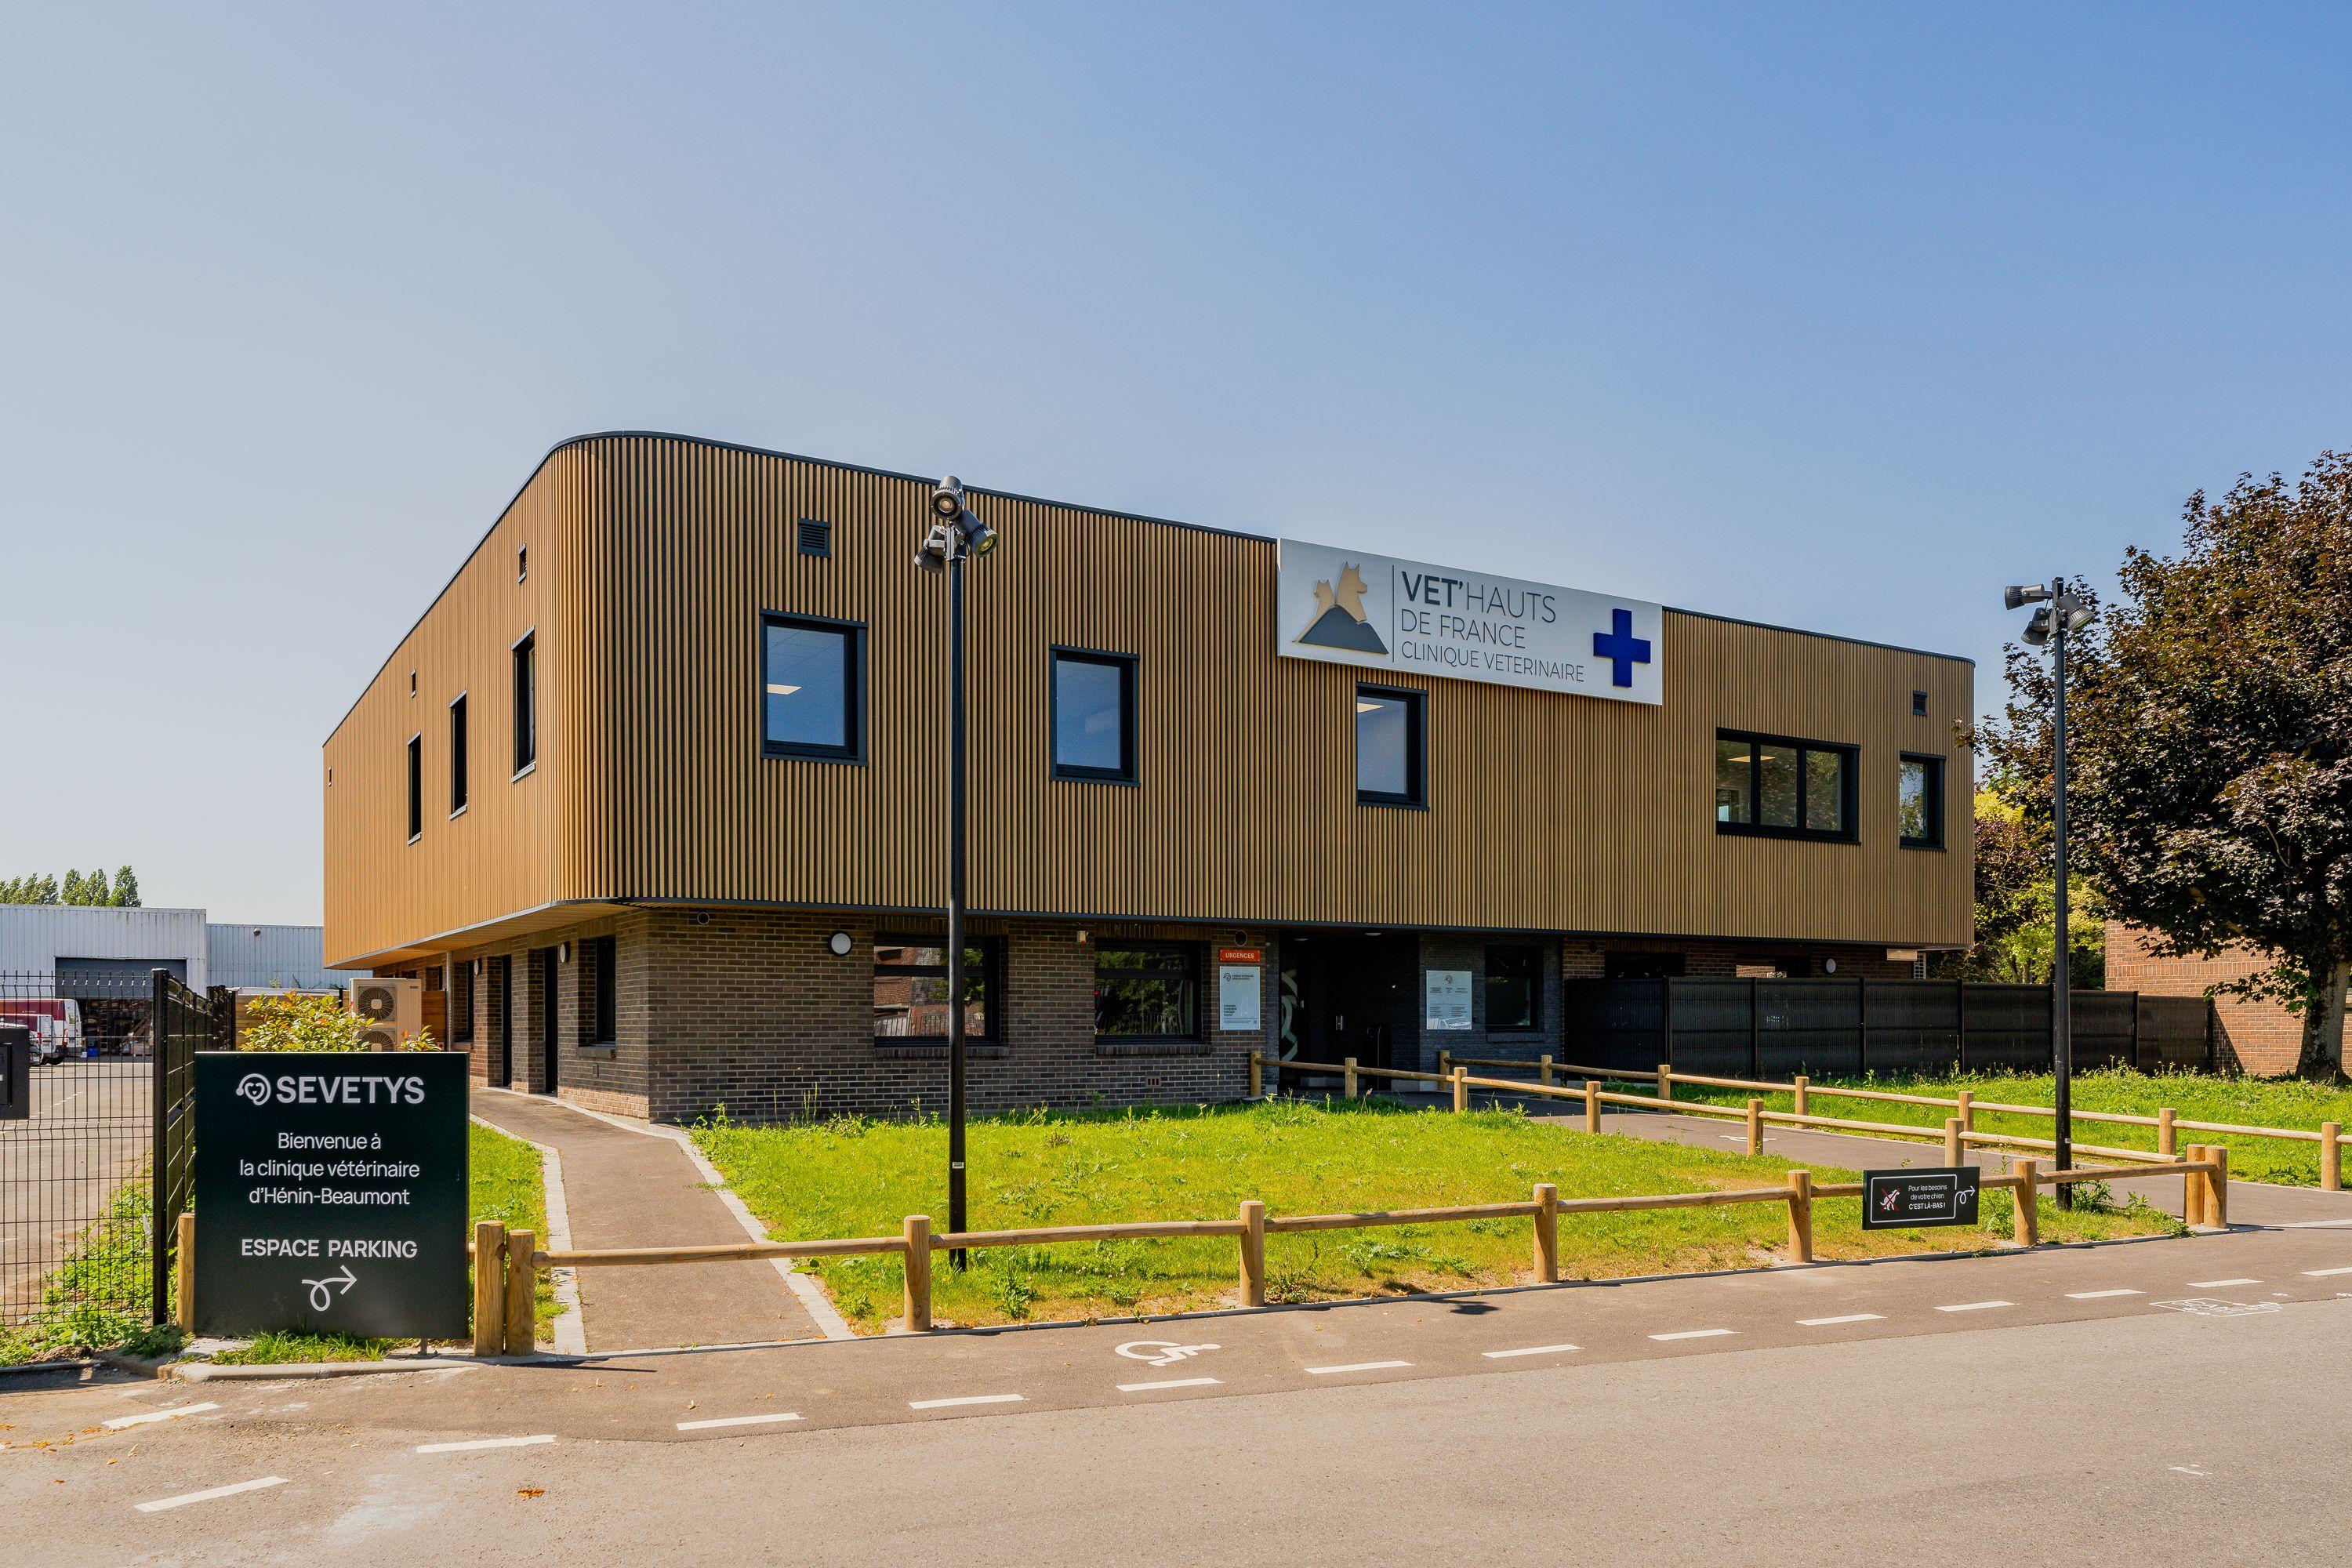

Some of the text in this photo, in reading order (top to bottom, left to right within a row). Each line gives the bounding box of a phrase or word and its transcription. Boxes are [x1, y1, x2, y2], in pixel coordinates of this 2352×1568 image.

[1402, 571, 1556, 623] VET'HAUTS
[1402, 608, 1526, 649] DE FRANCE
[1402, 641, 1584, 682] CLINIQUE VETERINAIRE
[276, 1076, 425, 1104] SEVETYS
[278, 1132, 382, 1149] Bienvenue à
[240, 1160, 419, 1181] la clinique vétérinaire
[249, 1187, 410, 1204] d'Hénin-Beaumont
[241, 1239, 418, 1258] ESPACE PARKING
